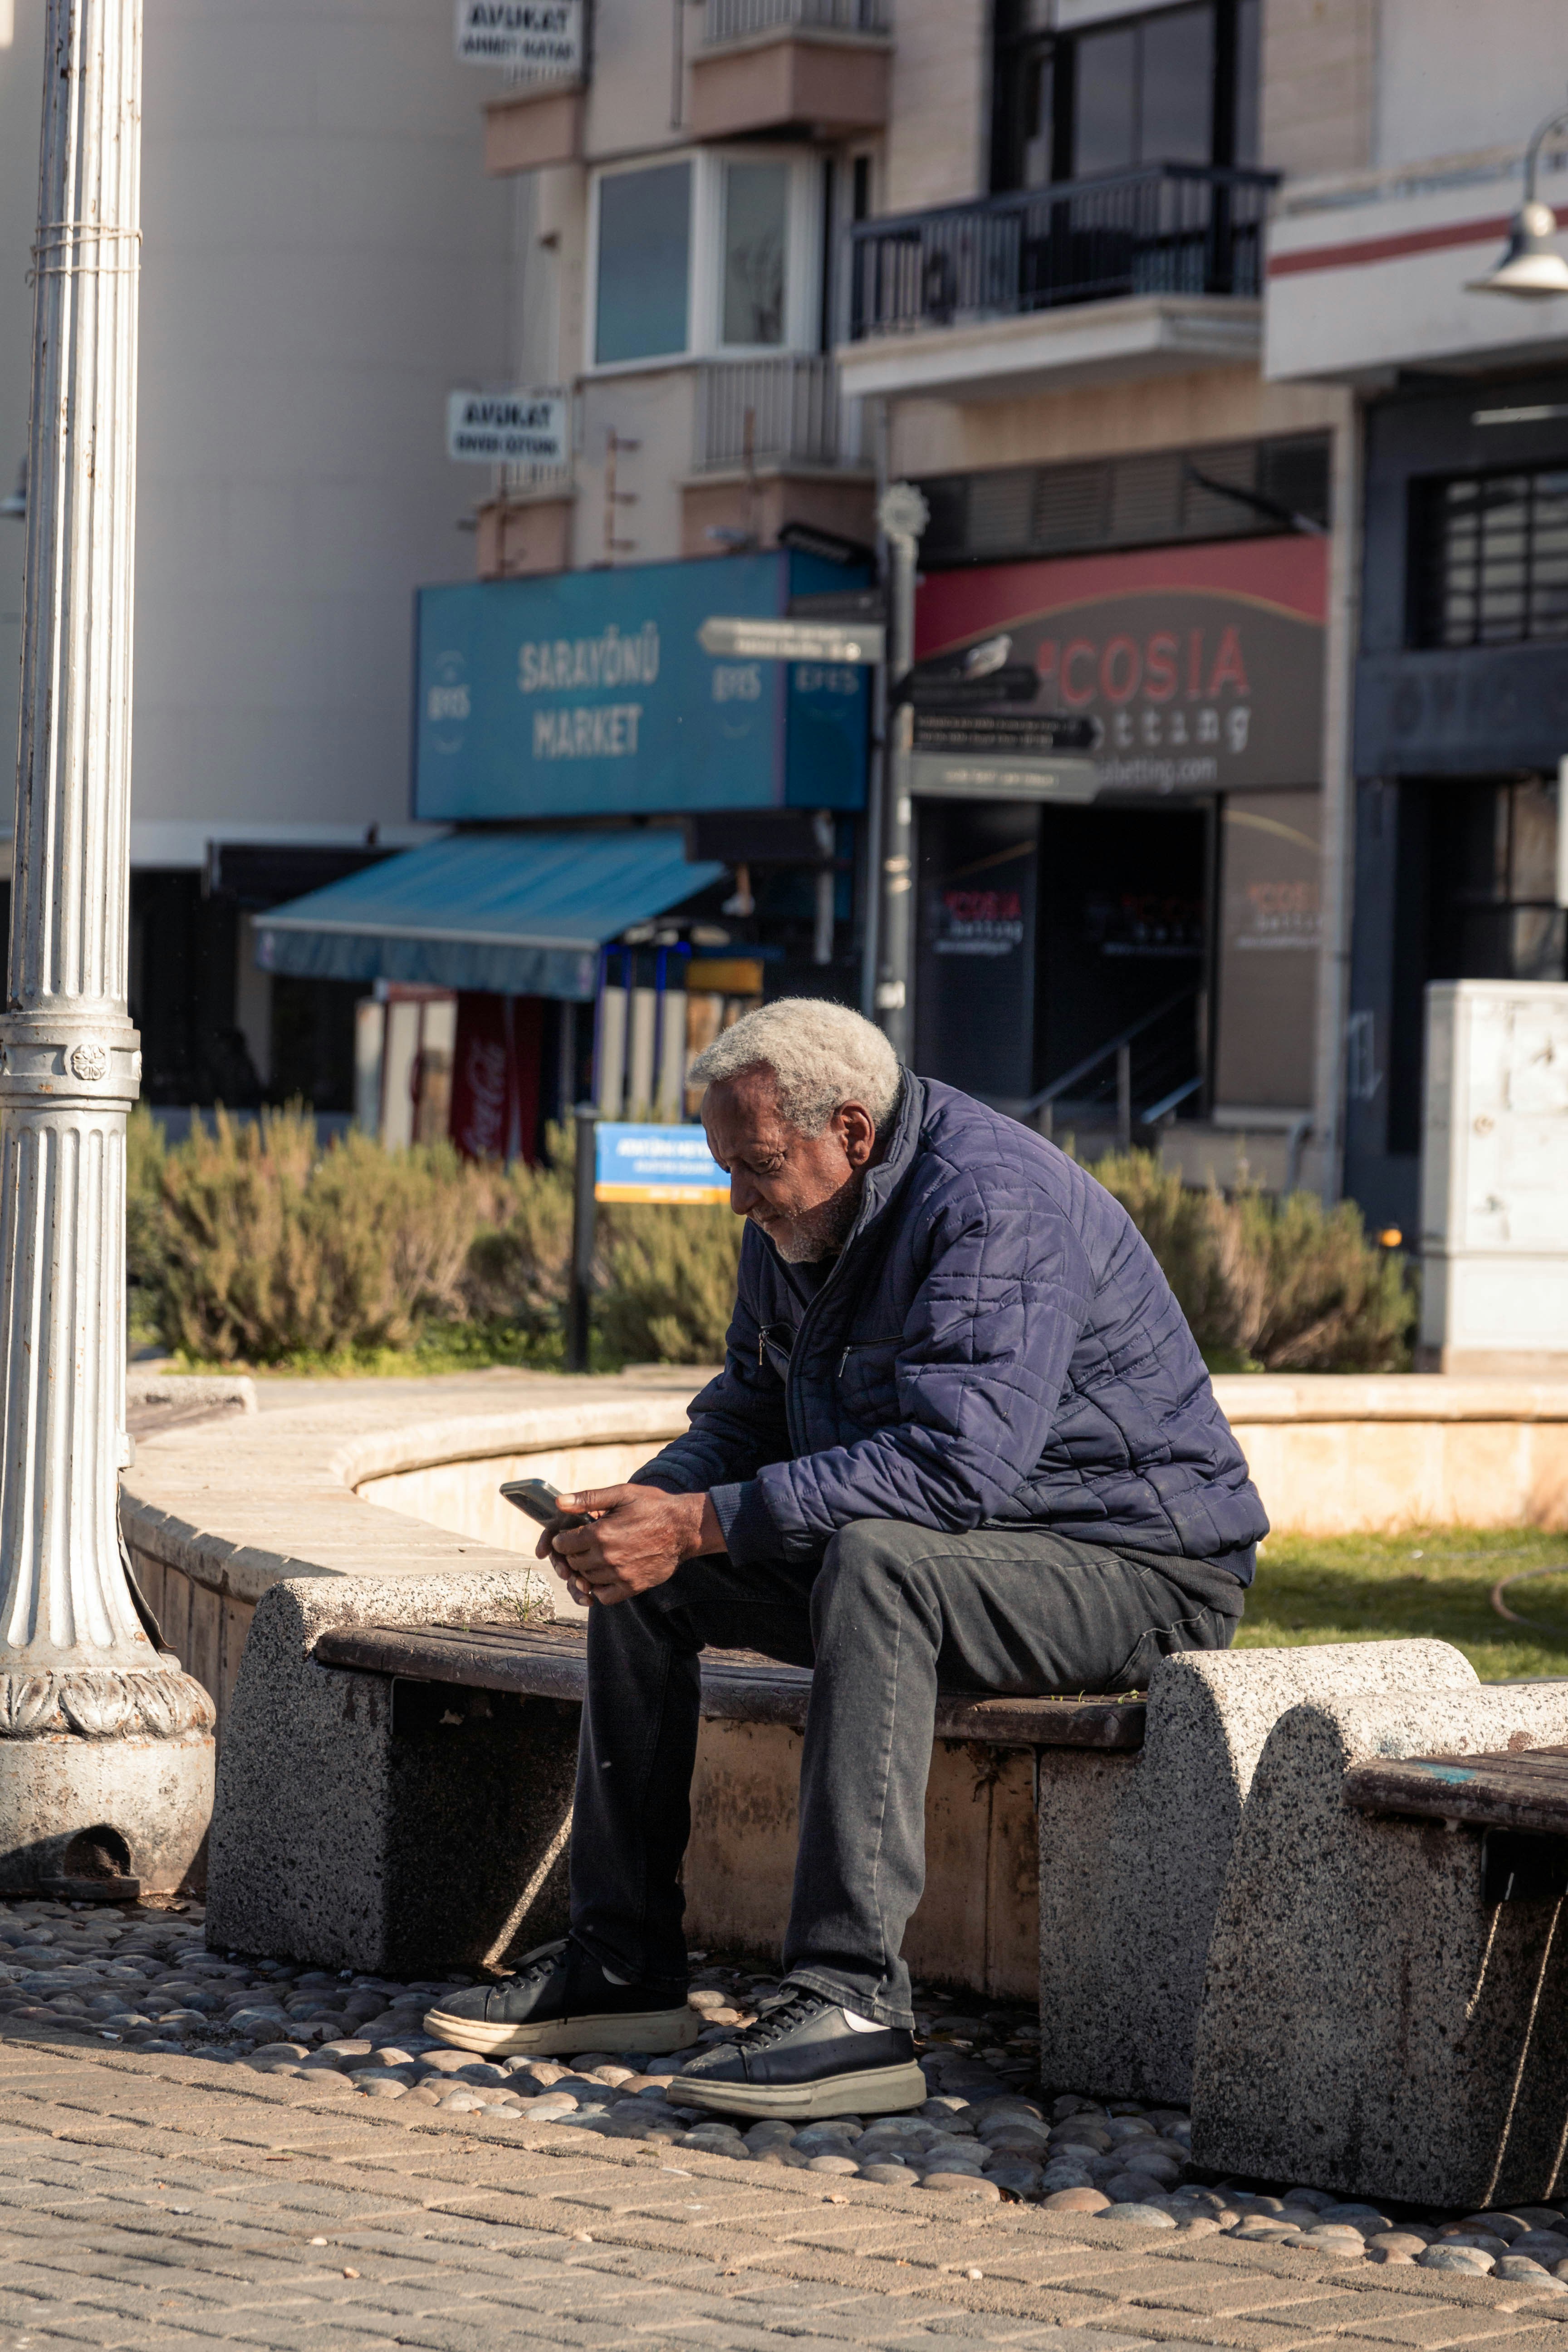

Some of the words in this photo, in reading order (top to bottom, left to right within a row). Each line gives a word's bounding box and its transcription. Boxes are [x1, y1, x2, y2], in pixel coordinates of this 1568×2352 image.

[469, 4, 569, 33] AVUKAT
[463, 401, 553, 428] AVUKAT
[532, 703, 642, 760] MARKET
